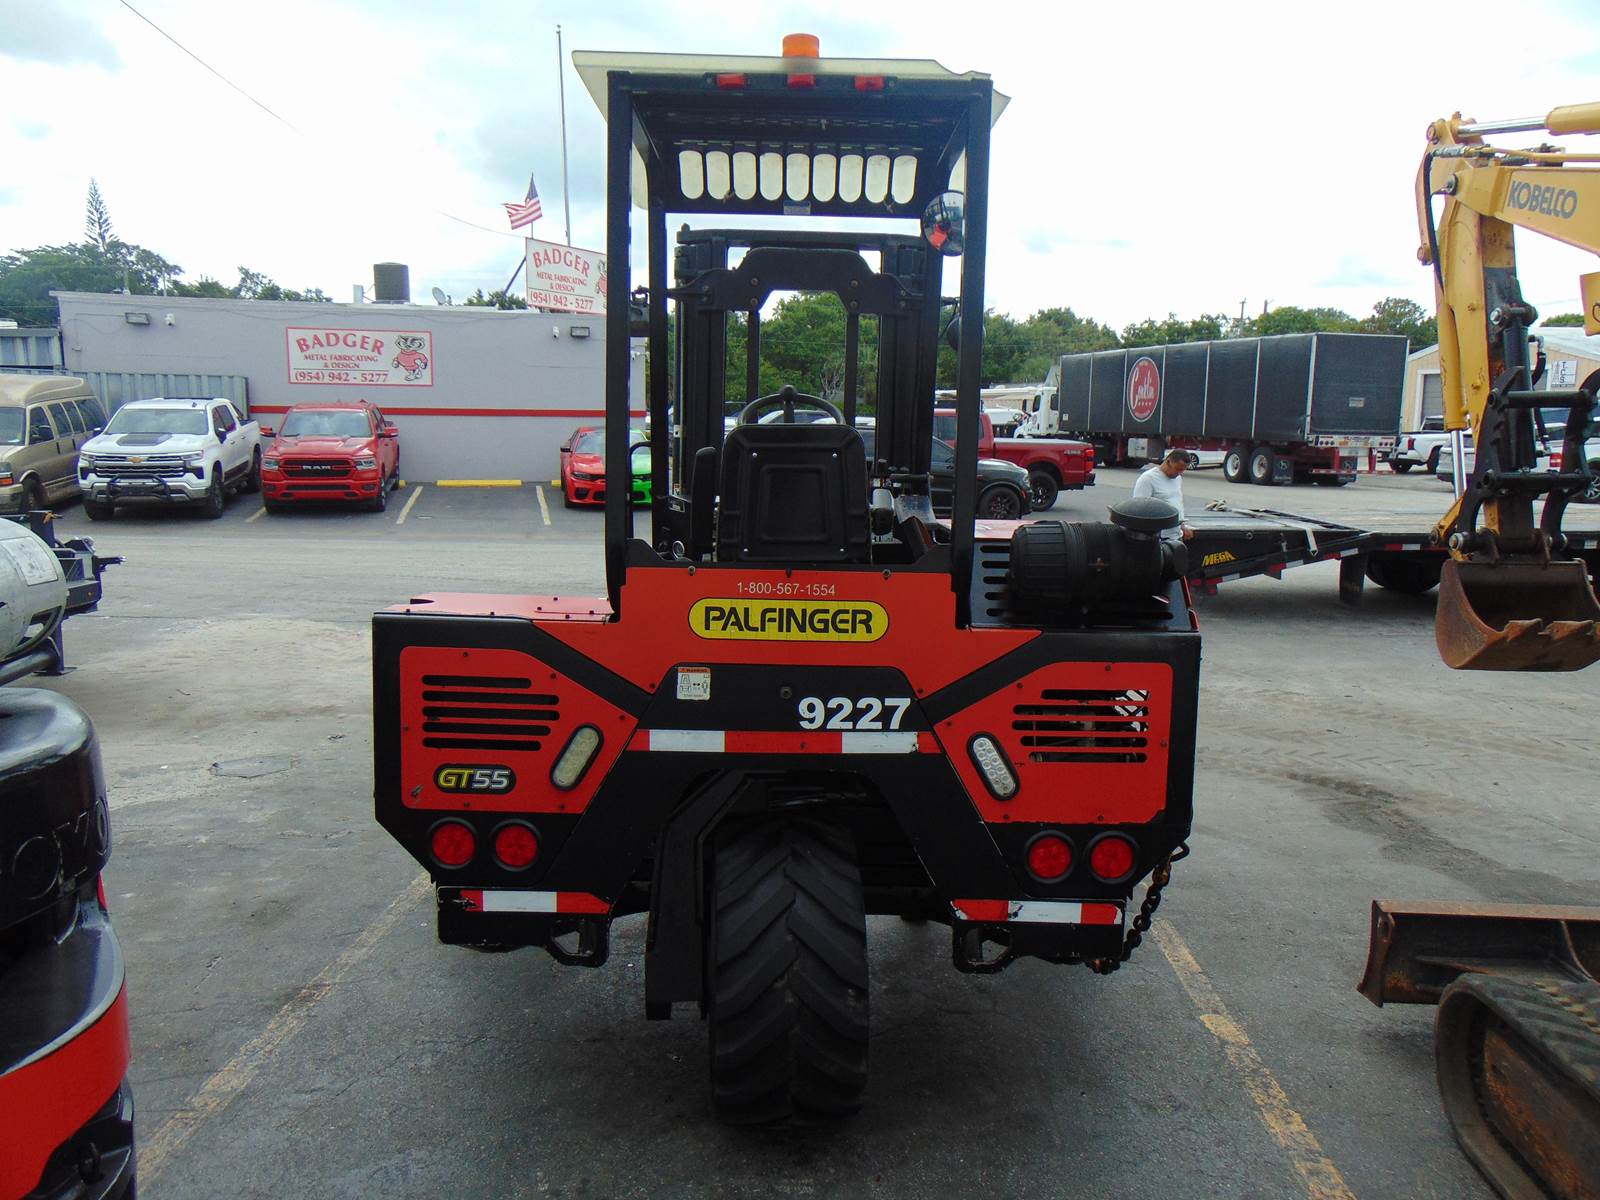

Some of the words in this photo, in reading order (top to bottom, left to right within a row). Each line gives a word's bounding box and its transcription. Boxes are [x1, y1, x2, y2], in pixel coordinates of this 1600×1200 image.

[1508, 180, 1578, 219] KOBELCO
[533, 248, 590, 278] BADGER
[537, 271, 553, 281] METAL
[554, 274, 587, 286] FABRICATING
[555, 283, 575, 292] DESIGN
[531, 291, 551, 305] (954)
[553, 295, 568, 307] 942
[575, 298, 594, 310] 5277
[296, 332, 385, 355] BADGER
[330, 354, 378, 362] FABRICATING
[295, 372, 325, 382] (954)
[328, 372, 350, 382] 942
[361, 373, 389, 383] 5277
[1202, 551, 1237, 567] MEGA
[737, 582, 836, 596] 1-800-567-1554
[704, 606, 873, 634] PALFINGER
[798, 697, 911, 730] 9227
[438, 768, 511, 789] GT55
